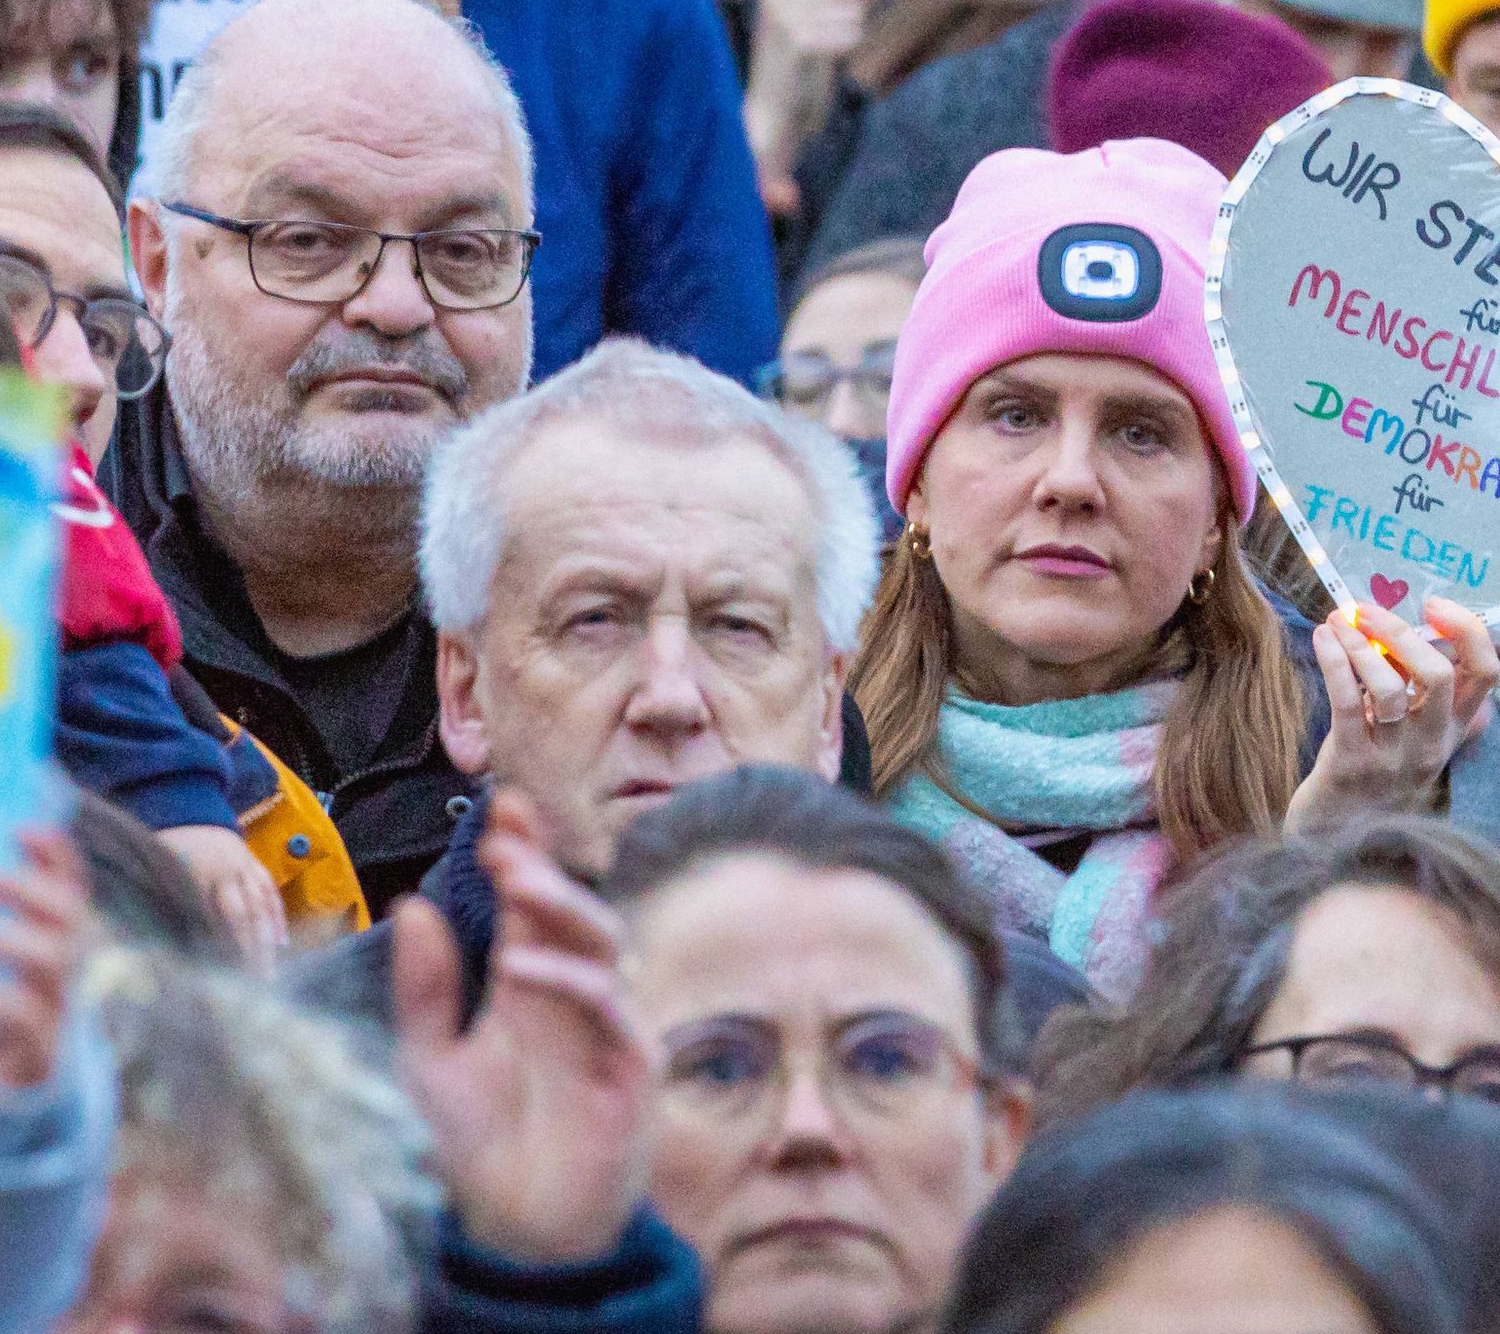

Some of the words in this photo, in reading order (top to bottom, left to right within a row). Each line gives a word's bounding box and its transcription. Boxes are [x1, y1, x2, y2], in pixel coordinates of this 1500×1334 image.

[1302, 128, 1401, 220] WIR
[1412, 383, 1472, 428] für
[1393, 474, 1444, 514] für
[1304, 482, 1490, 588] FRIEDEN
